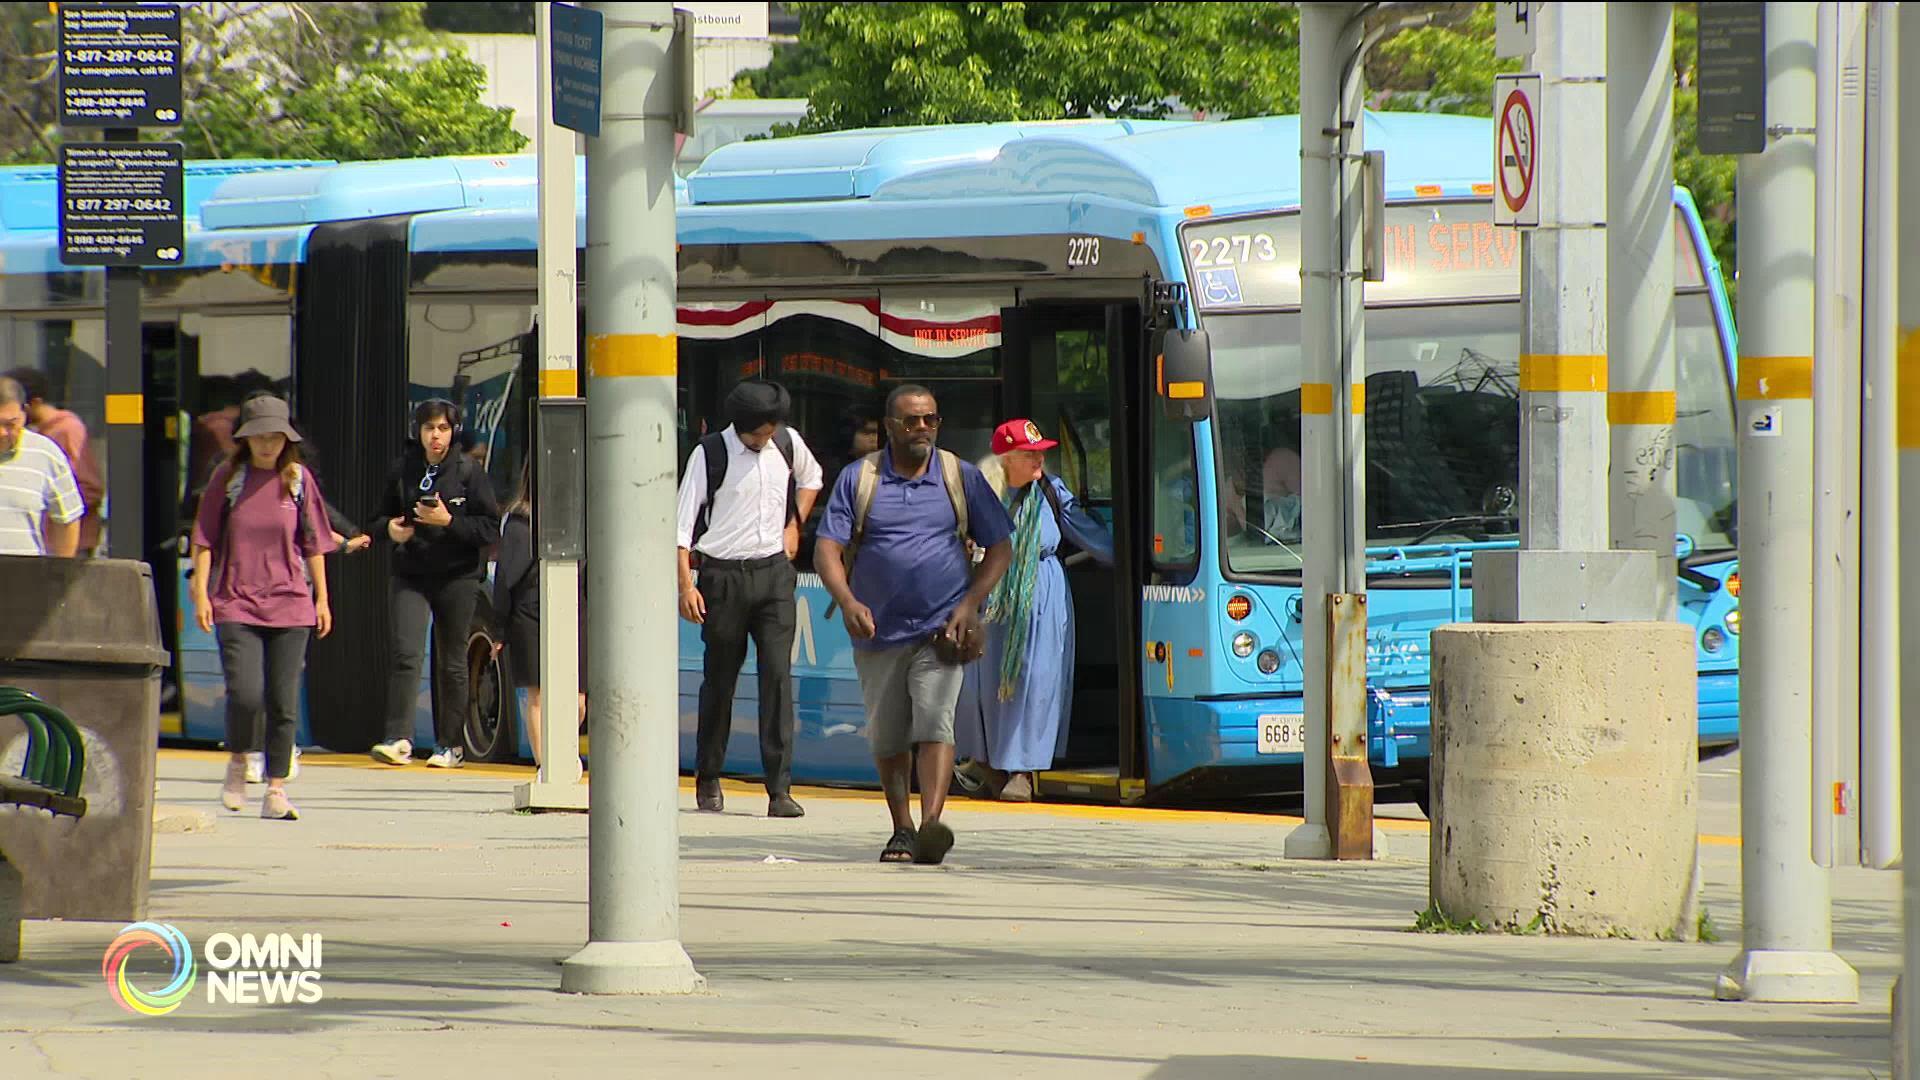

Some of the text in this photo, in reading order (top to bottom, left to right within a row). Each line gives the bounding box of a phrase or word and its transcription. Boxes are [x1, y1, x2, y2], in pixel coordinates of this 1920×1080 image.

[64, 10, 175, 21] See Something Suspicious?
[64, 20, 128, 31] Say Something!
[64, 50, 174, 62] 1-877-297-0642
[65, 66, 80, 75] For
[139, 66, 157, 75] call
[66, 199, 172, 210] 1 877 297-0642
[1068, 237, 1100, 265] 2273
[1190, 233, 1277, 267] 2273
[1428, 220, 1518, 272] SERV
[914, 327, 988, 348] NOT IN SERVICE
